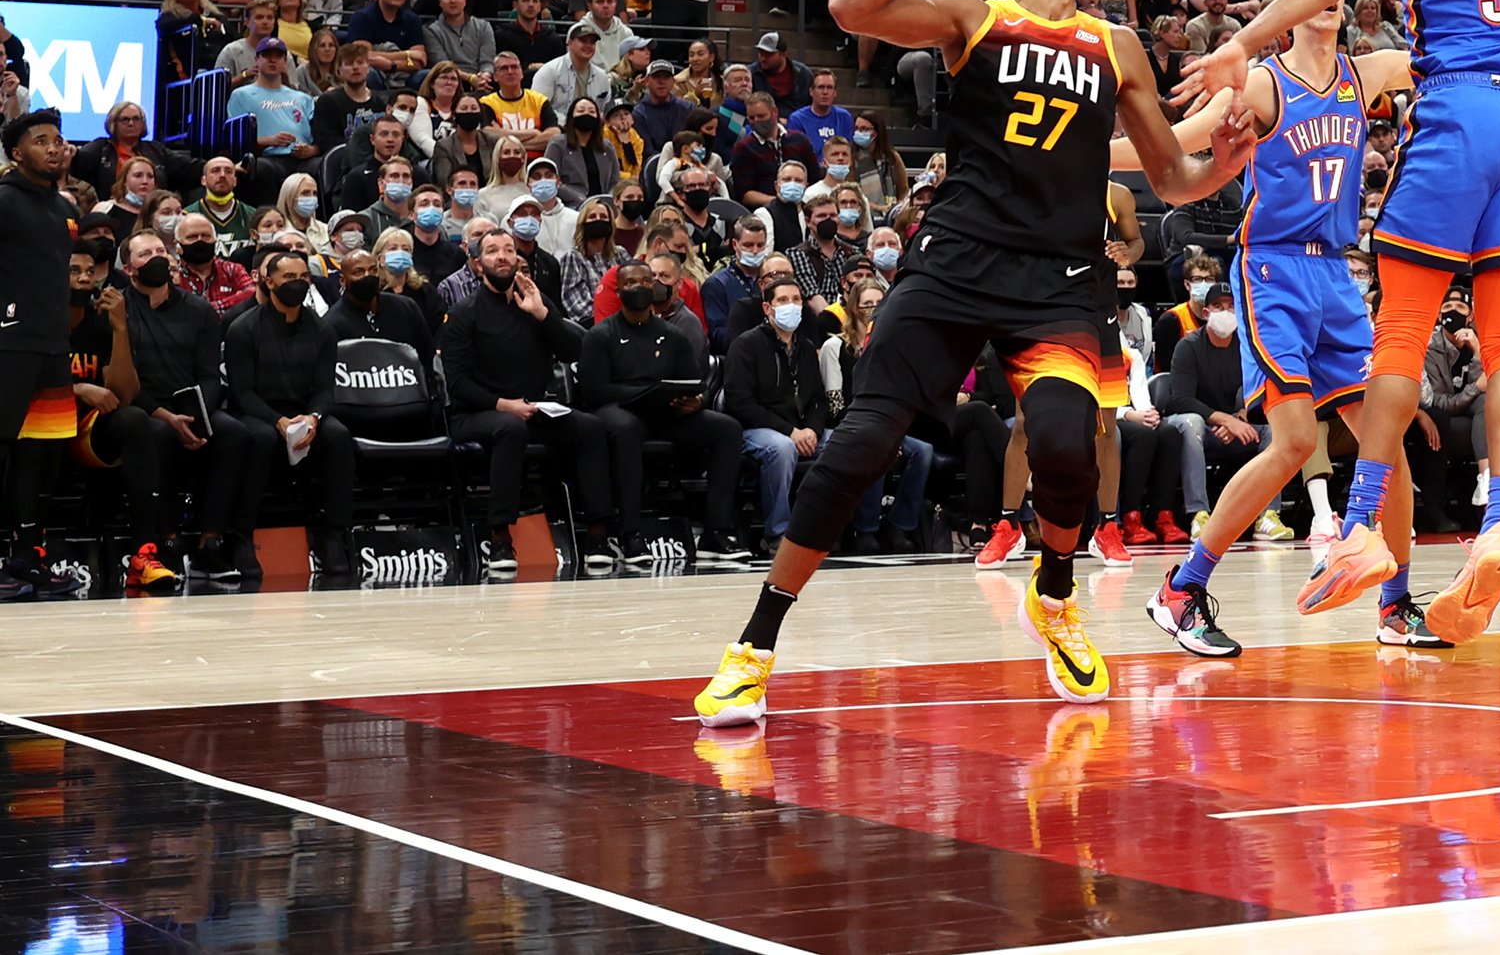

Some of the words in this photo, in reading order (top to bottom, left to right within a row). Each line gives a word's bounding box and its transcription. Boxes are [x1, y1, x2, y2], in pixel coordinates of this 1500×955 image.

[21, 38, 143, 114] XM
[998, 43, 1100, 104] UTAH
[1003, 90, 1079, 151] 27
[1282, 113, 1362, 157] THUNDER
[1308, 156, 1347, 203] 17
[335, 362, 418, 388] Smith's
[360, 546, 448, 573] Smith's
